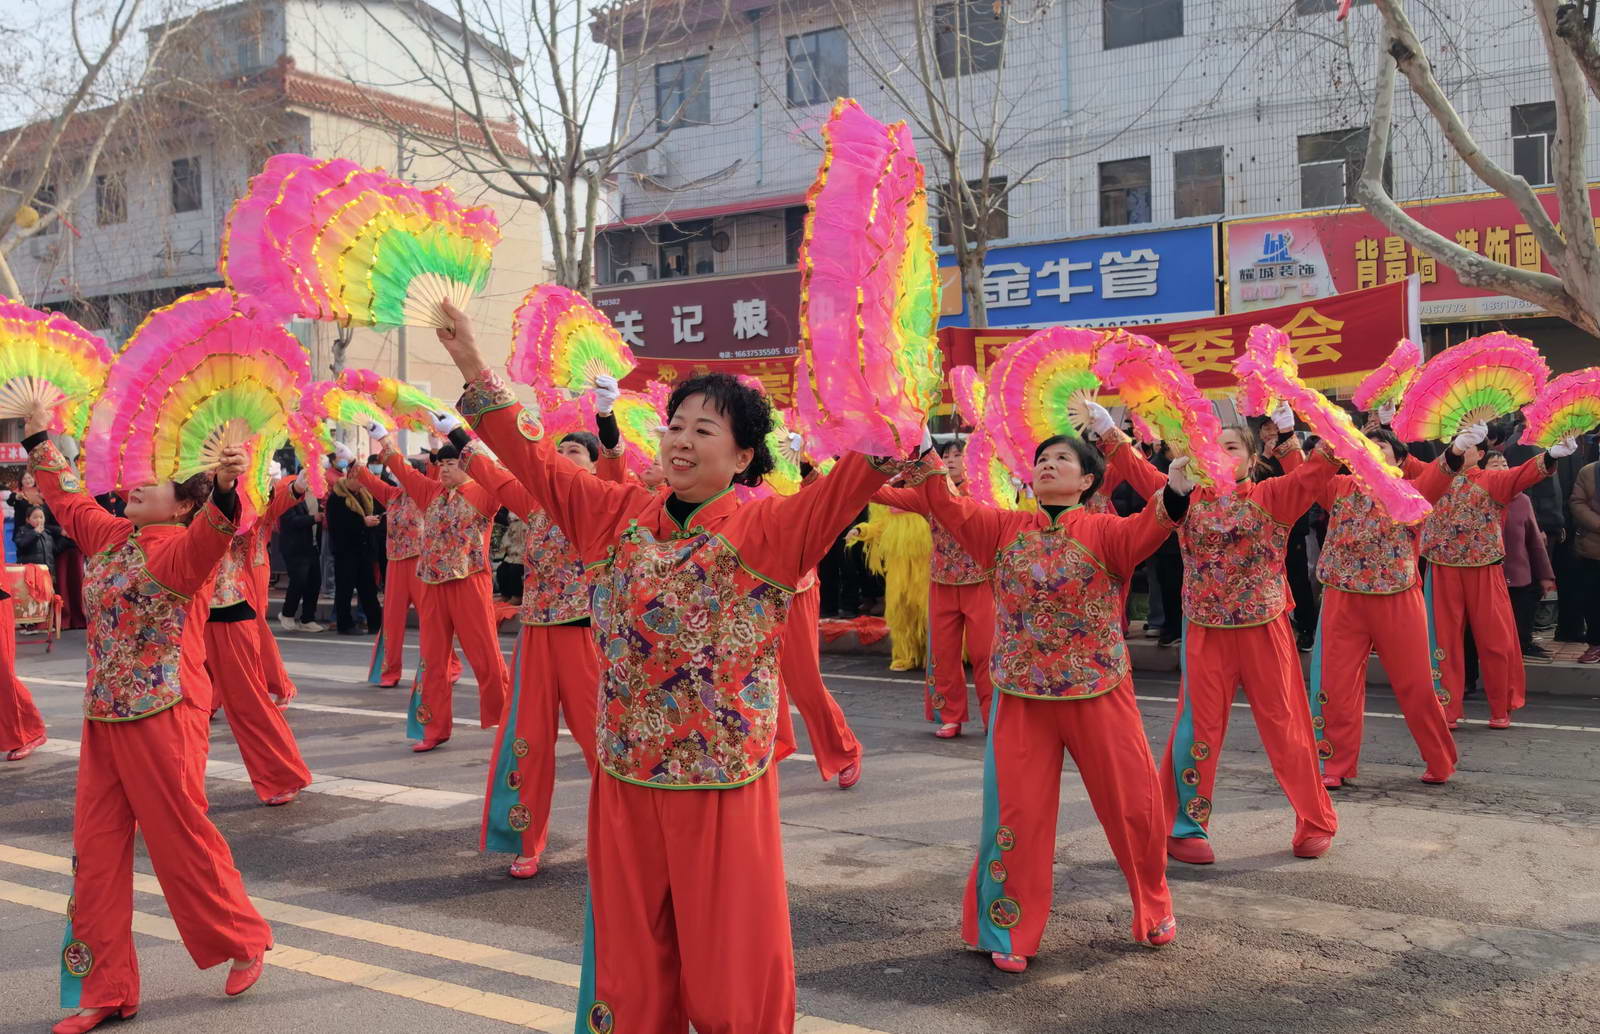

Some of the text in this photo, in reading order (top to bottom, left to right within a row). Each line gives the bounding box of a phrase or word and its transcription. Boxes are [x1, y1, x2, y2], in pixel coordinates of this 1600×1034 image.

[983, 249, 1160, 309] 金牛管
[784, 344, 801, 354] 037
